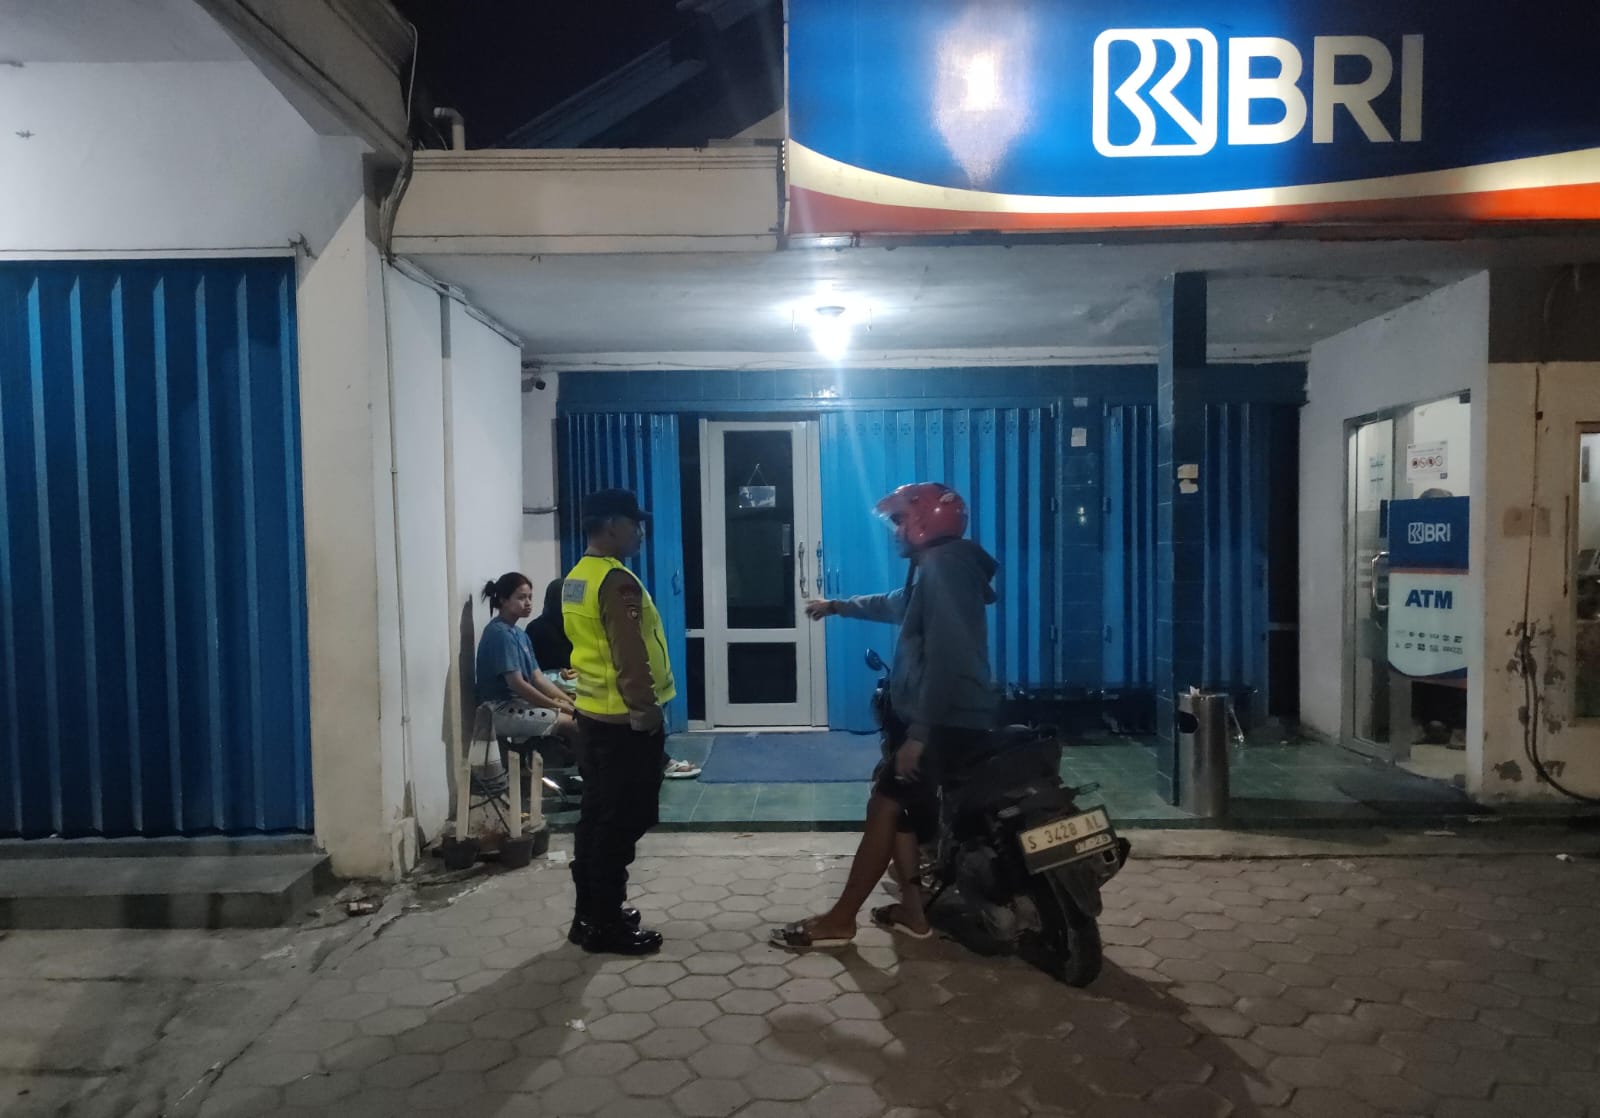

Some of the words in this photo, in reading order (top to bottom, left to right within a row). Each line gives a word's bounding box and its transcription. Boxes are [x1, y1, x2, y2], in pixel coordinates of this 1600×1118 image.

[1228, 35, 1423, 145] BRI
[1424, 523, 1451, 542] BRI
[1405, 590, 1453, 609] ATM
[1027, 835, 1037, 850] S
